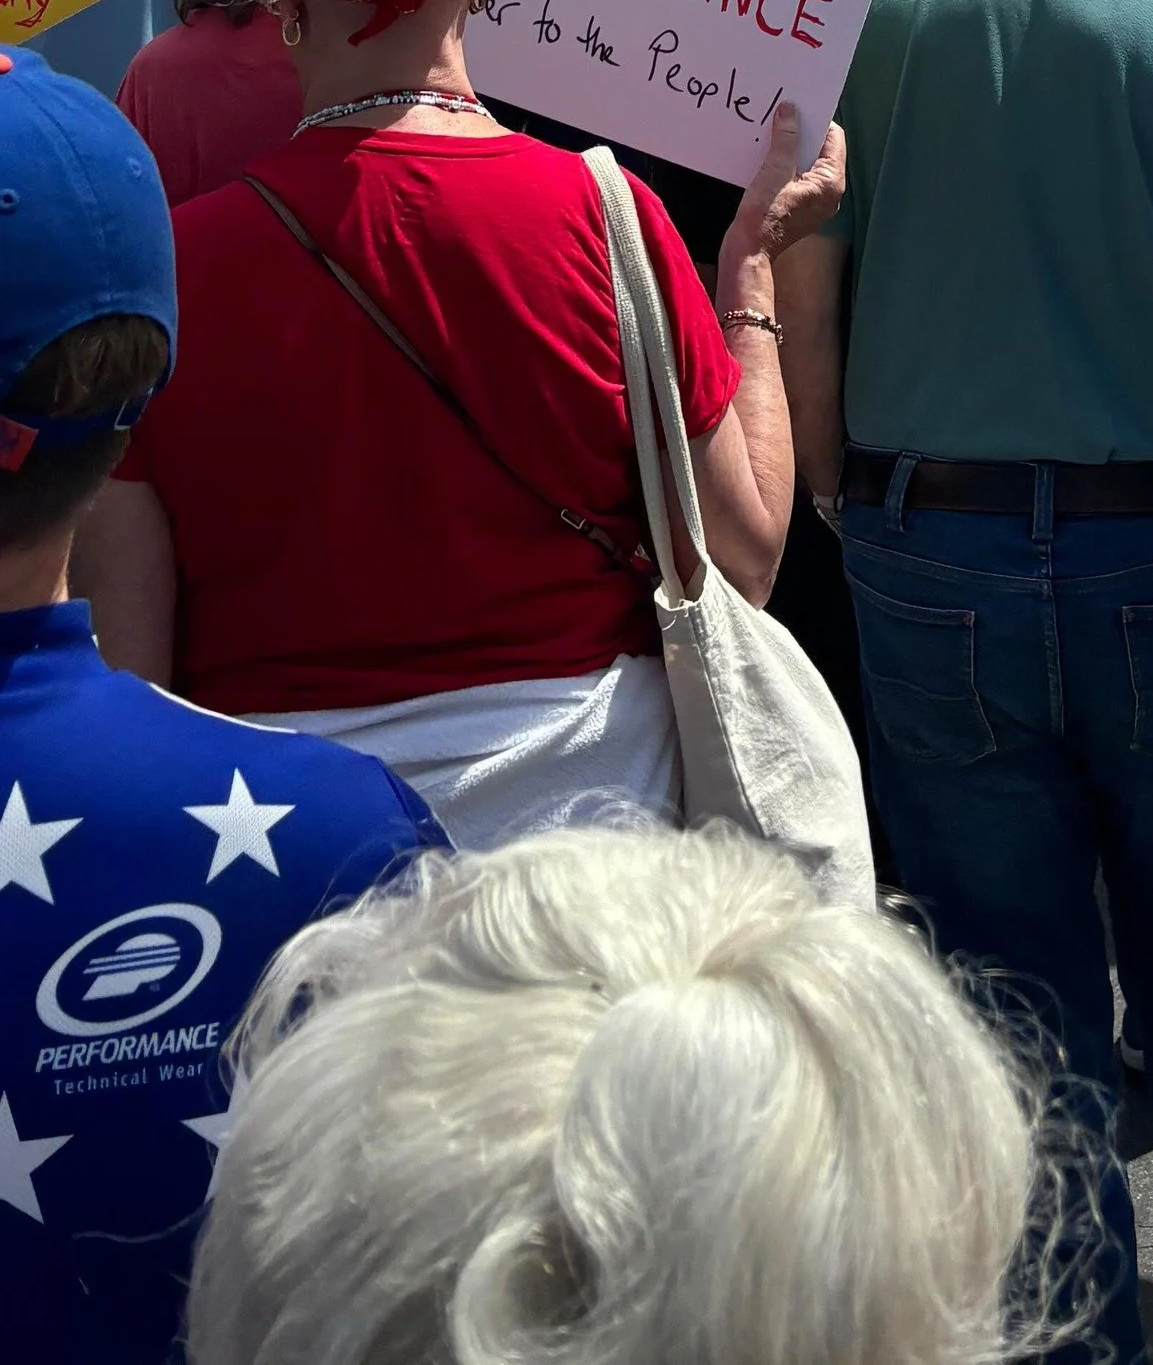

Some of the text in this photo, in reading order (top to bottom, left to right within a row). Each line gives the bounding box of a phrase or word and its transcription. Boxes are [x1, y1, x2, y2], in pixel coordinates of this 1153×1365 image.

[577, 16, 621, 67] the
[648, 29, 784, 143] People!
[35, 1021, 221, 1073] PERFORMANCE
[54, 1062, 204, 1096] Technical Wear
